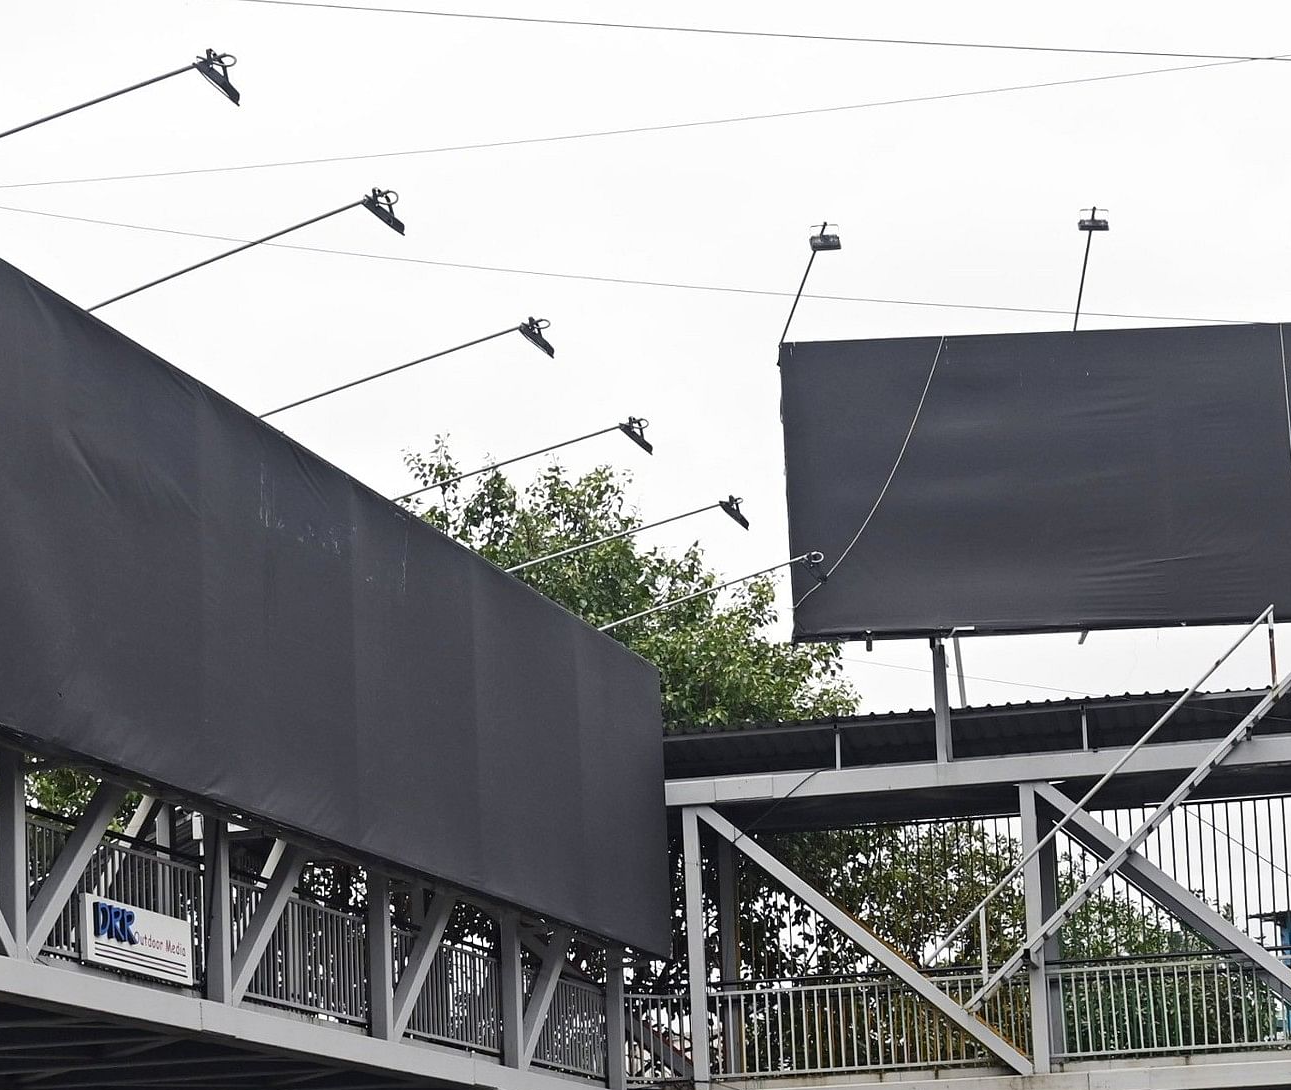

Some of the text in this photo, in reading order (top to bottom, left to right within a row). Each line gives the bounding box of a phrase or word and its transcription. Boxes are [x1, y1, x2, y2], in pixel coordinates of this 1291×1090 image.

[93, 901, 187, 957] DRR Outdoor Media
